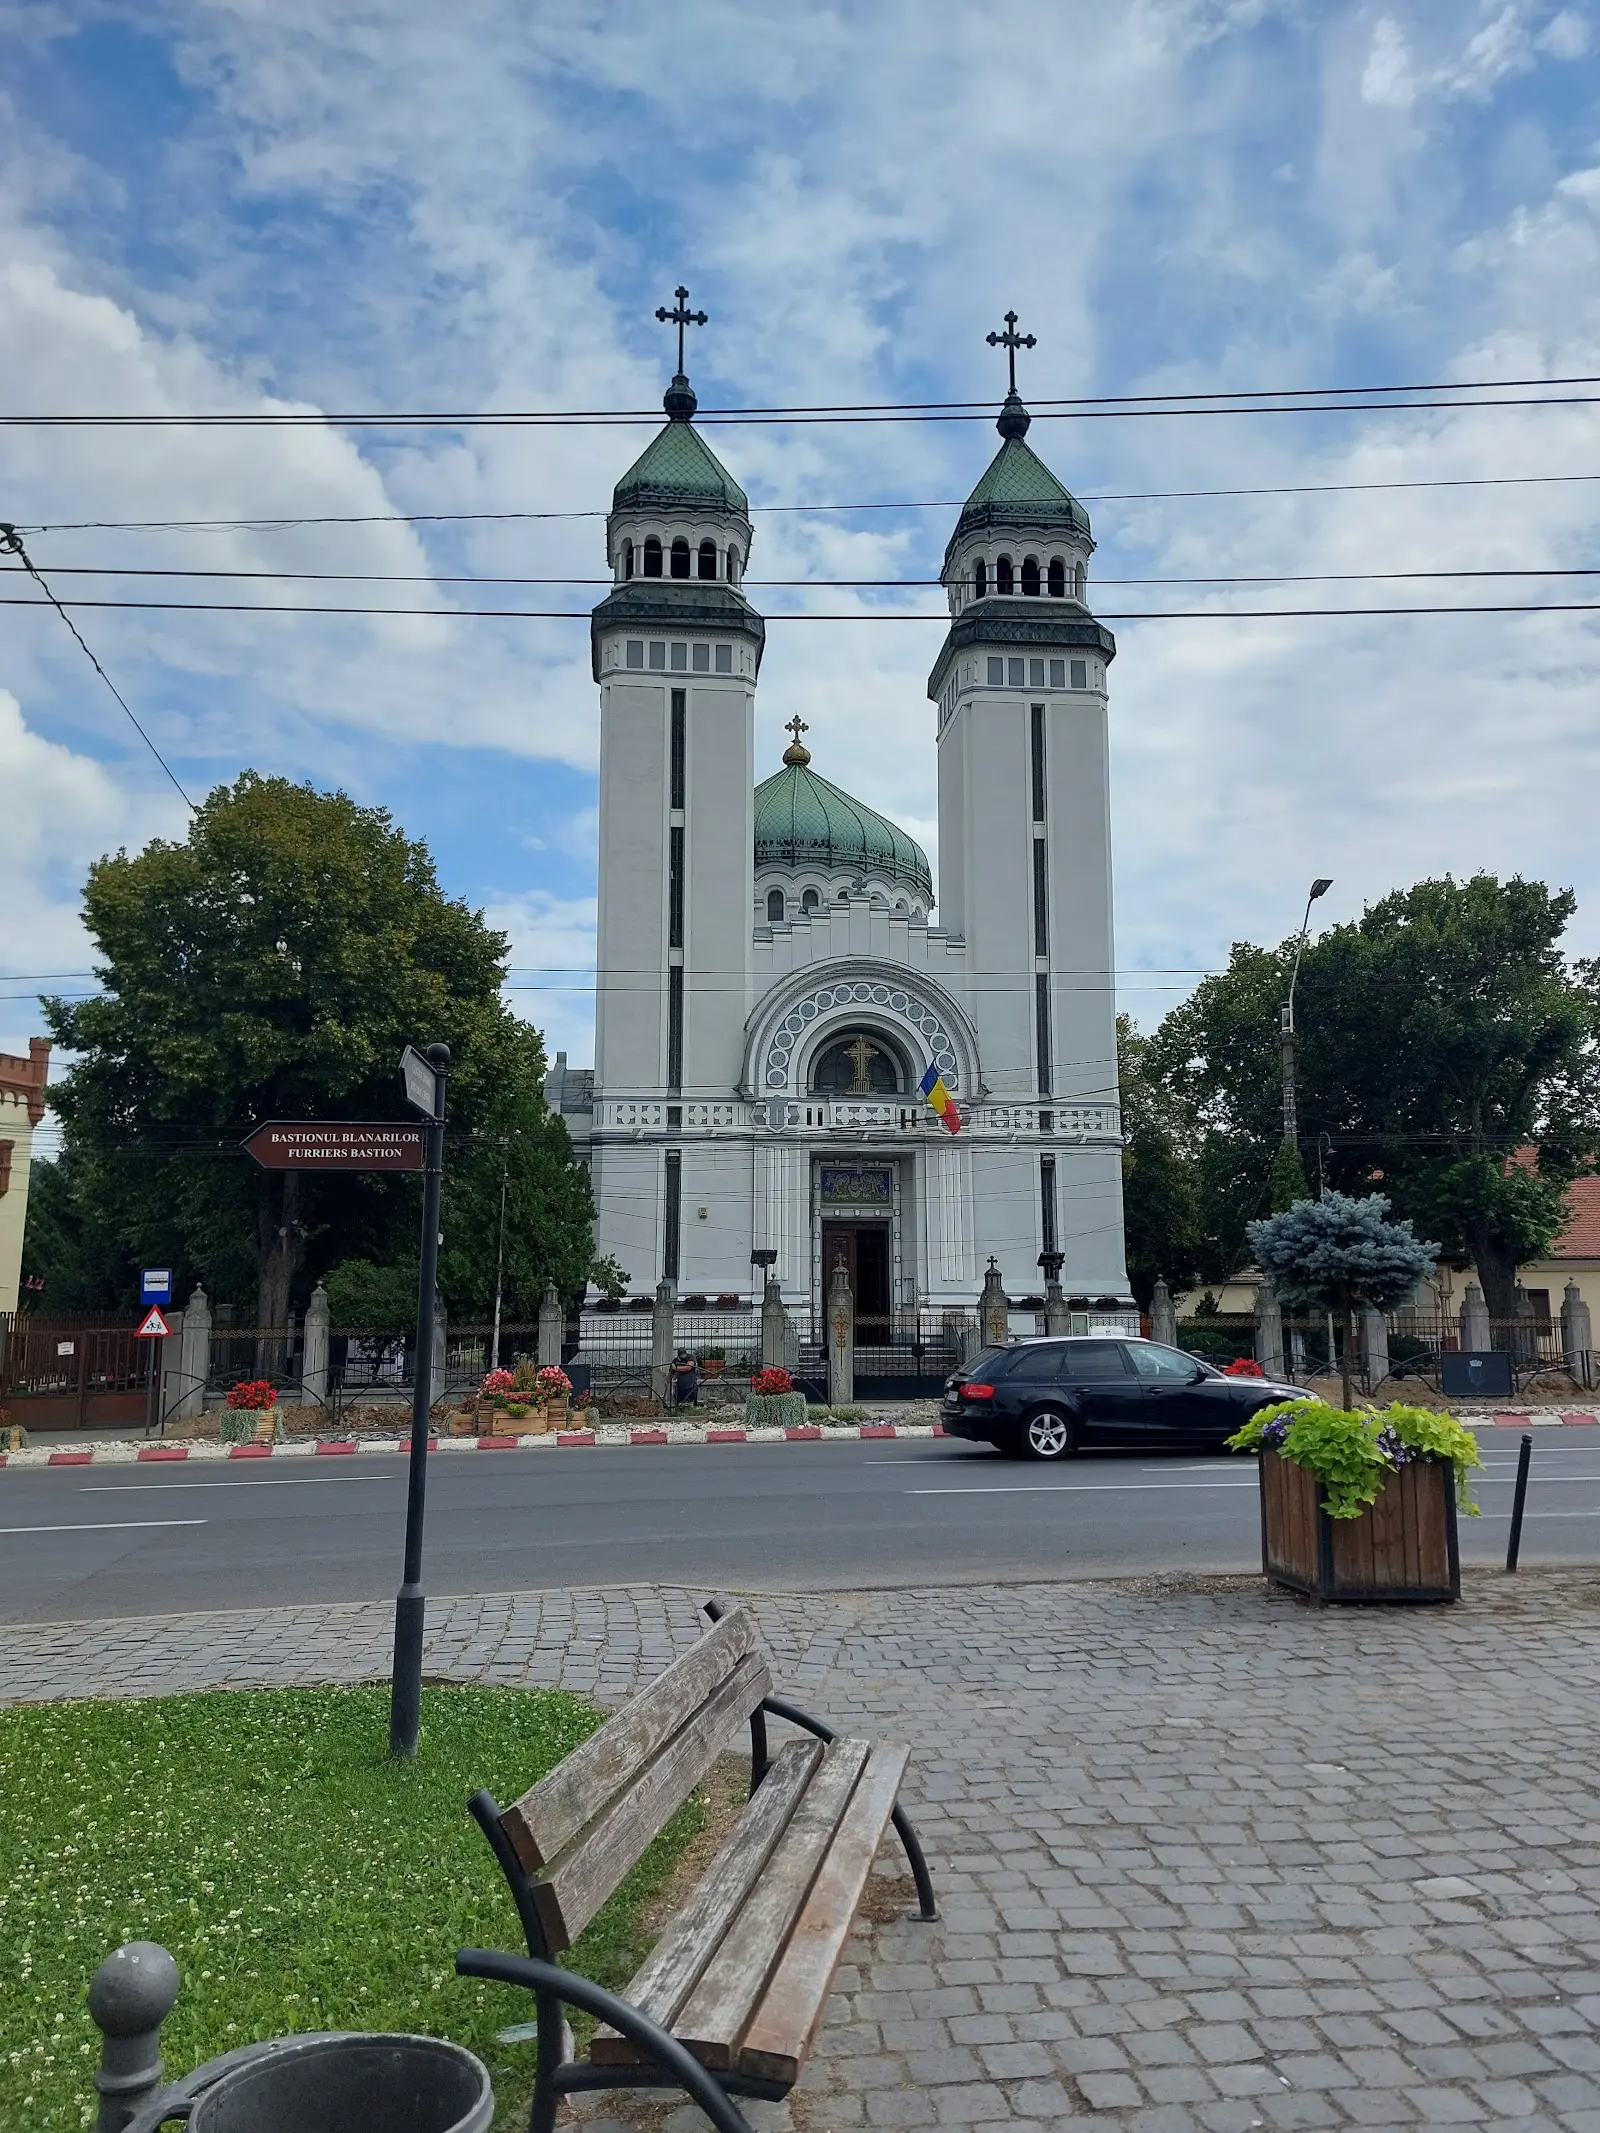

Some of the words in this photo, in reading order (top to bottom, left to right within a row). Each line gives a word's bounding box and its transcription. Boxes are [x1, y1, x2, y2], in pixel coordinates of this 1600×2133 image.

[271, 1133, 340, 1143] BASTIONUL
[342, 1133, 420, 1143] BLANARILOR
[288, 1149, 348, 1158] FURRIERS
[350, 1149, 402, 1158] BASTION
